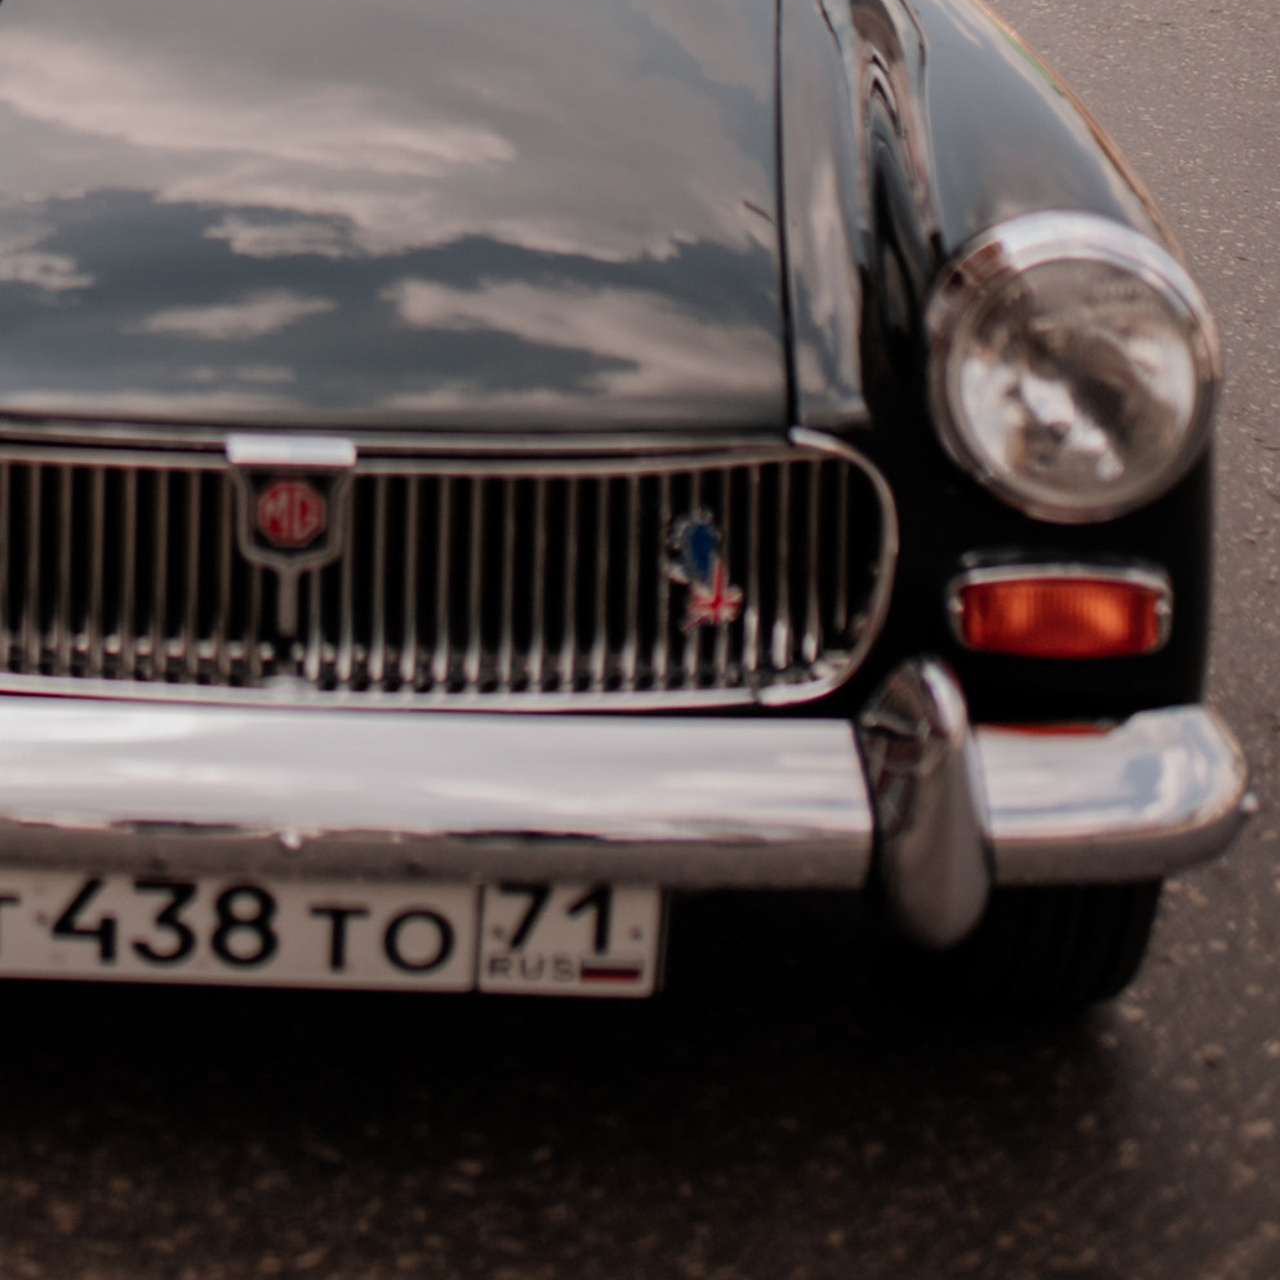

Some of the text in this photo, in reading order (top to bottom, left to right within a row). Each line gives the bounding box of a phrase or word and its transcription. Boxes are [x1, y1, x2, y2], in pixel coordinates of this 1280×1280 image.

[262, 487, 319, 539] MG
[51, 876, 279, 970] 438
[499, 880, 612, 955] 71
[488, 957, 575, 982] RUS
